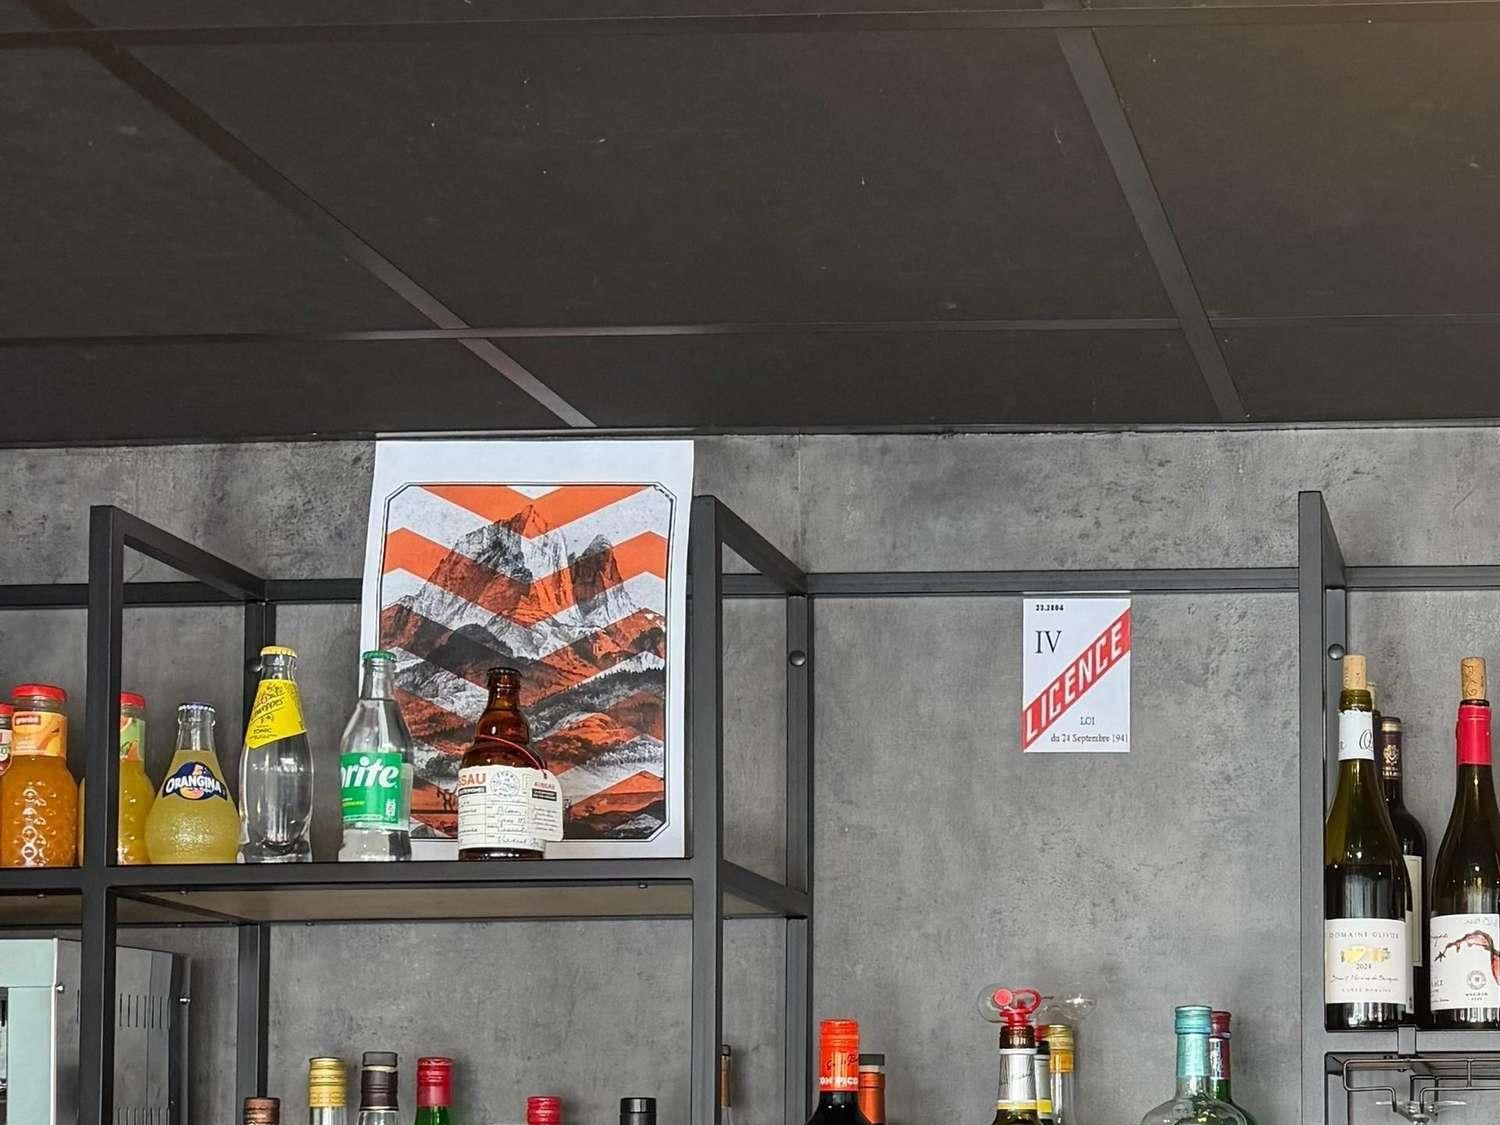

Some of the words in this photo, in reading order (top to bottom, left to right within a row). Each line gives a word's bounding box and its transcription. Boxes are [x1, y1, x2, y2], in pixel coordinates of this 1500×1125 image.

[1034, 630, 1062, 654] IV
[1025, 620, 1123, 743] LICENCE
[1079, 716, 1095, 726] LOI
[165, 774, 223, 796] ORANGINA
